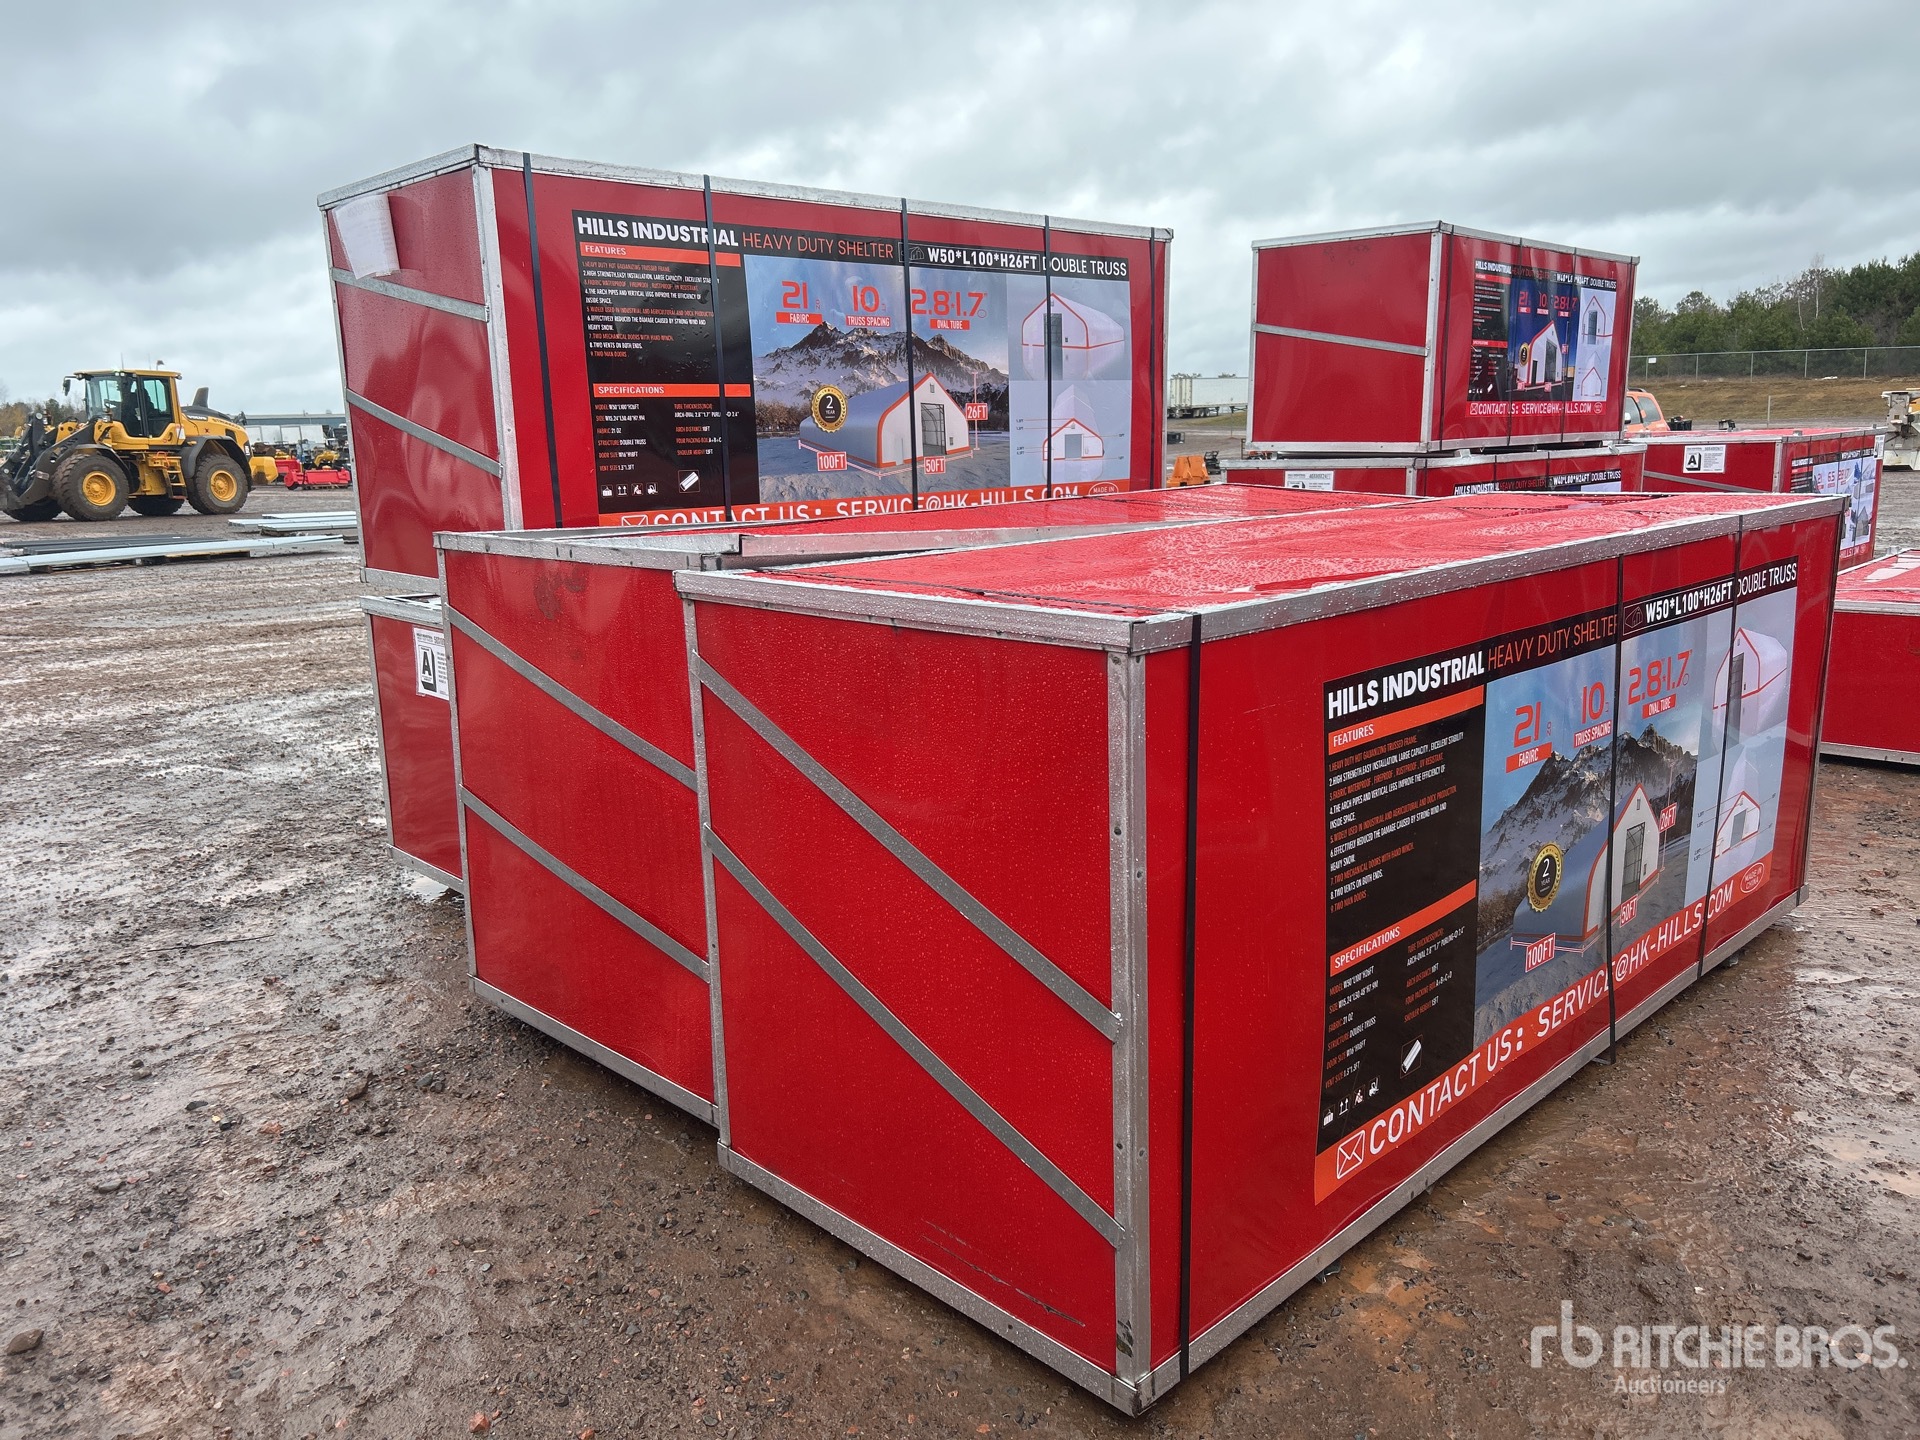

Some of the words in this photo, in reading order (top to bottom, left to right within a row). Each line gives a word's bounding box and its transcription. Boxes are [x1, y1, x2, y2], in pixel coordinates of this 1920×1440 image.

[578, 217, 628, 238] HILLS
[633, 222, 738, 246] INDUSTRIAL
[743, 232, 792, 250] HEAVY
[798, 237, 834, 253] DUTY
[838, 240, 893, 258] SHELTER
[585, 245, 626, 255] FEATURES
[1090, 261, 1127, 277] TRUSS
[781, 281, 807, 308] 21
[852, 285, 880, 312] 10
[847, 316, 863, 325] TRUSS
[864, 316, 889, 326] SPACING
[937, 319, 948, 328] OVAL
[949, 320, 962, 329] TUBE
[826, 395, 833, 408] 2
[967, 406, 986, 419] 26FT
[1478, 403, 1506, 415] CONTACT
[1522, 403, 1591, 414] SERVICE@HK-ILLS.COM
[819, 455, 845, 470] 100FT
[926, 459, 944, 472] 50FT
[1688, 455, 1697, 465] A
[1592, 472, 1606, 481] DOUBLE
[1607, 471, 1621, 479] TRUSS
[1328, 679, 1378, 720] HILLS
[1383, 650, 1484, 703] INDUSTRIAL
[1488, 637, 1534, 670] HEAVY
[1537, 627, 1571, 657] DUTY
[1768, 562, 1797, 587] TRUSS
[422, 651, 432, 676] A
[1580, 678, 1605, 725] 10
[1333, 724, 1374, 747] FEATURES
[1513, 700, 1541, 749] 21
[1574, 728, 1590, 747] TRUSS
[1590, 720, 1610, 740] SPACING
[1518, 747, 1538, 767] FABIRC
[1660, 806, 1676, 830] 26FT
[1542, 856, 1550, 878] 2
[1621, 899, 1637, 924] 50FT
[1335, 925, 1400, 970] SPECIFICATIONS
[1528, 936, 1554, 968] 100FT
[1370, 1052, 1481, 1155] CONTACT
[1487, 1027, 1523, 1071] US:
